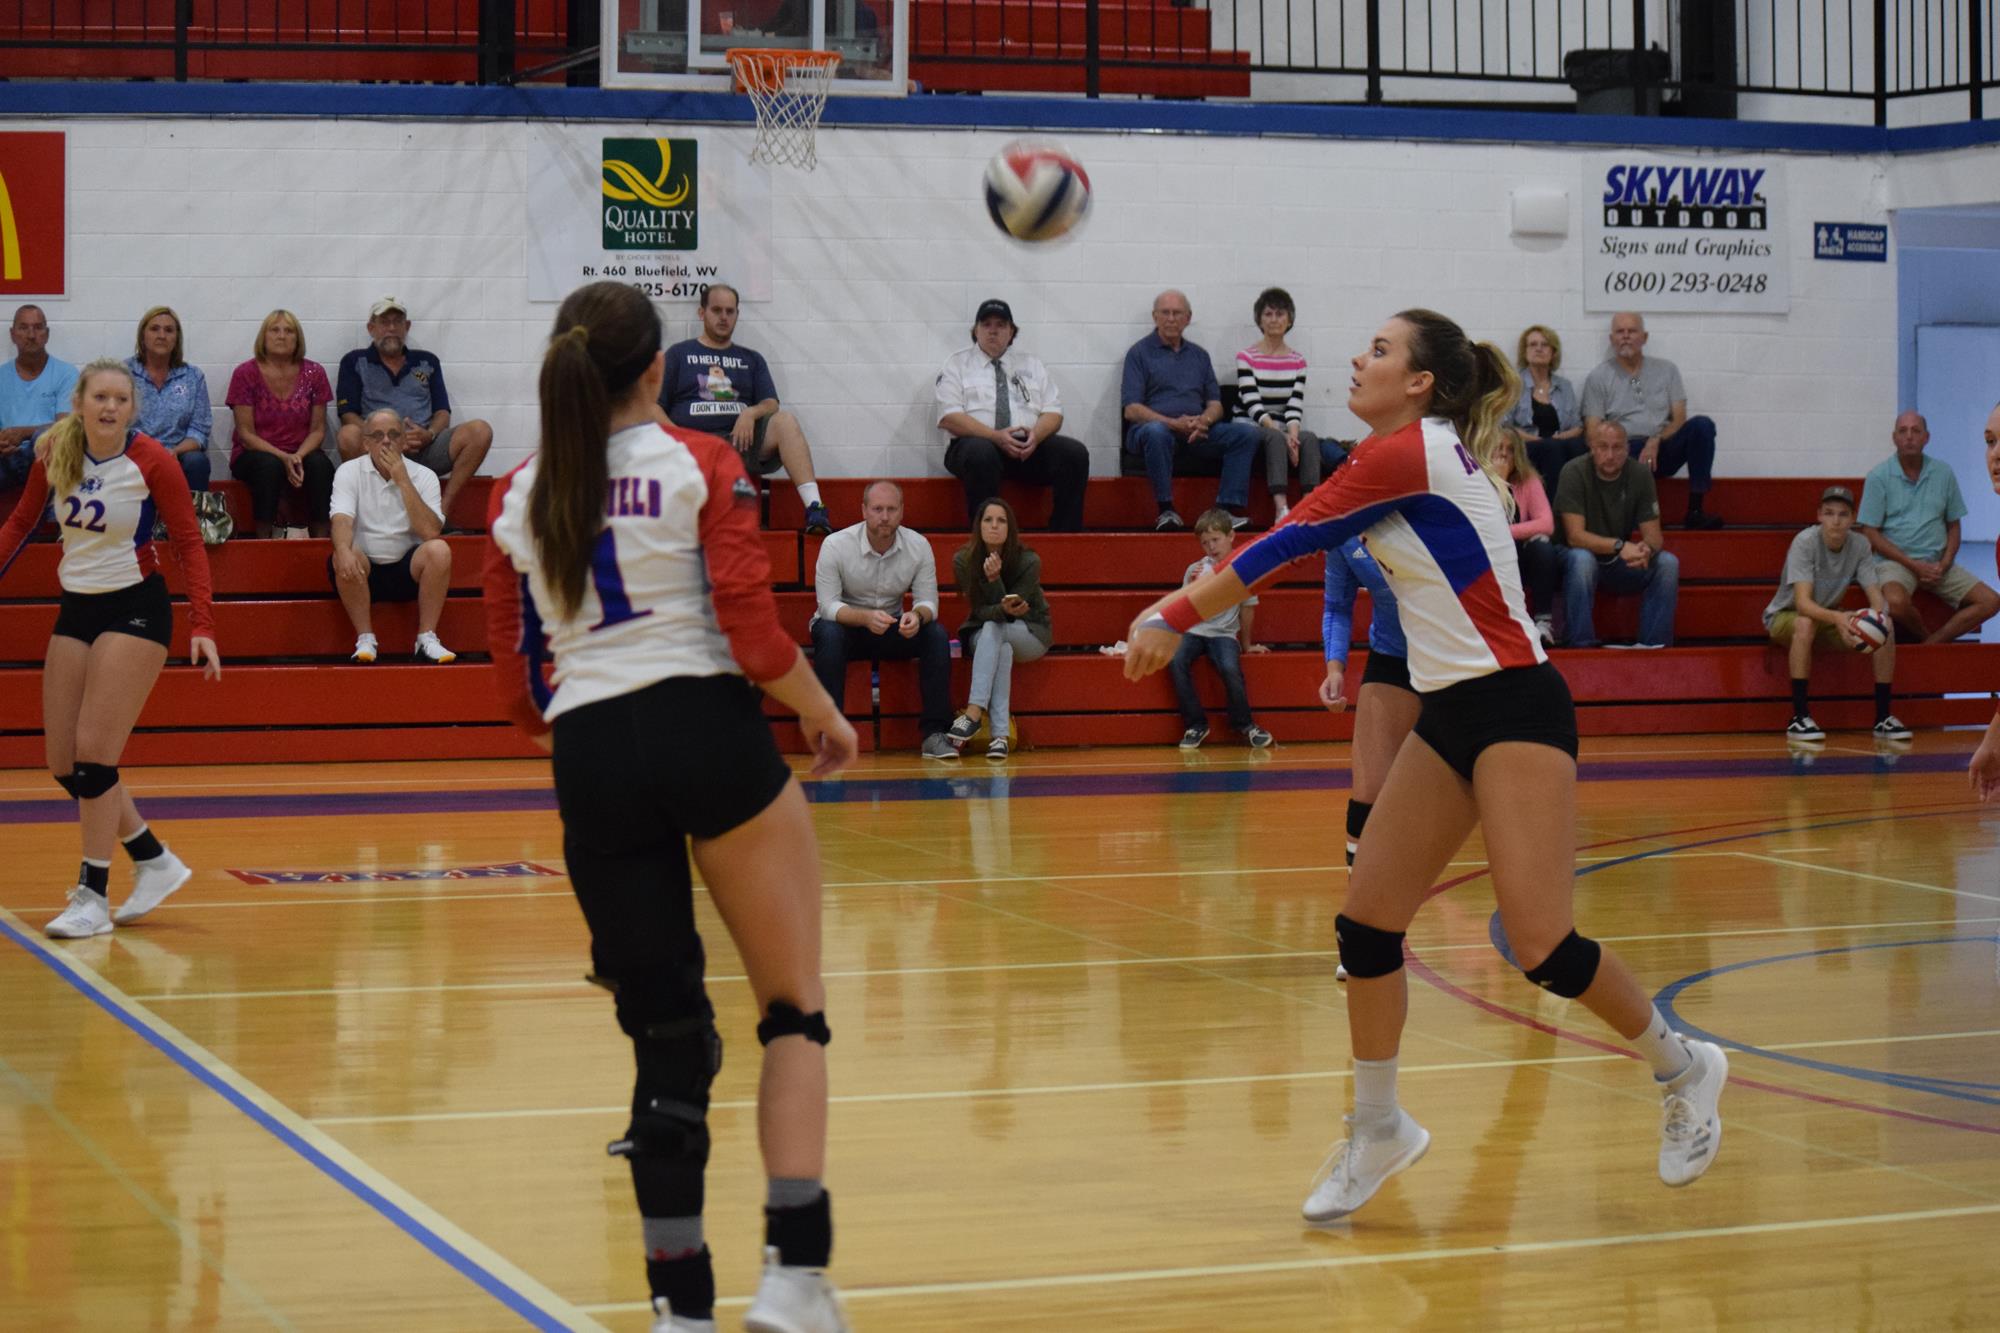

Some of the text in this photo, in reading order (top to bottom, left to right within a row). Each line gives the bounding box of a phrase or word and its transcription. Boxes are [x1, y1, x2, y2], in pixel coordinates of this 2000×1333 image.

[1604, 164, 1765, 207] SKYWAY
[605, 205, 695, 231] QUALITY
[1606, 208, 1763, 229] OUTDOOR
[624, 231, 675, 244] HOTEL
[1600, 236, 1772, 262] Signs and Graphics
[583, 265, 718, 279] Rt. 460 Bluefield, WV
[1604, 271, 1768, 295] (800) 293-0248
[63, 496, 107, 533] 22
